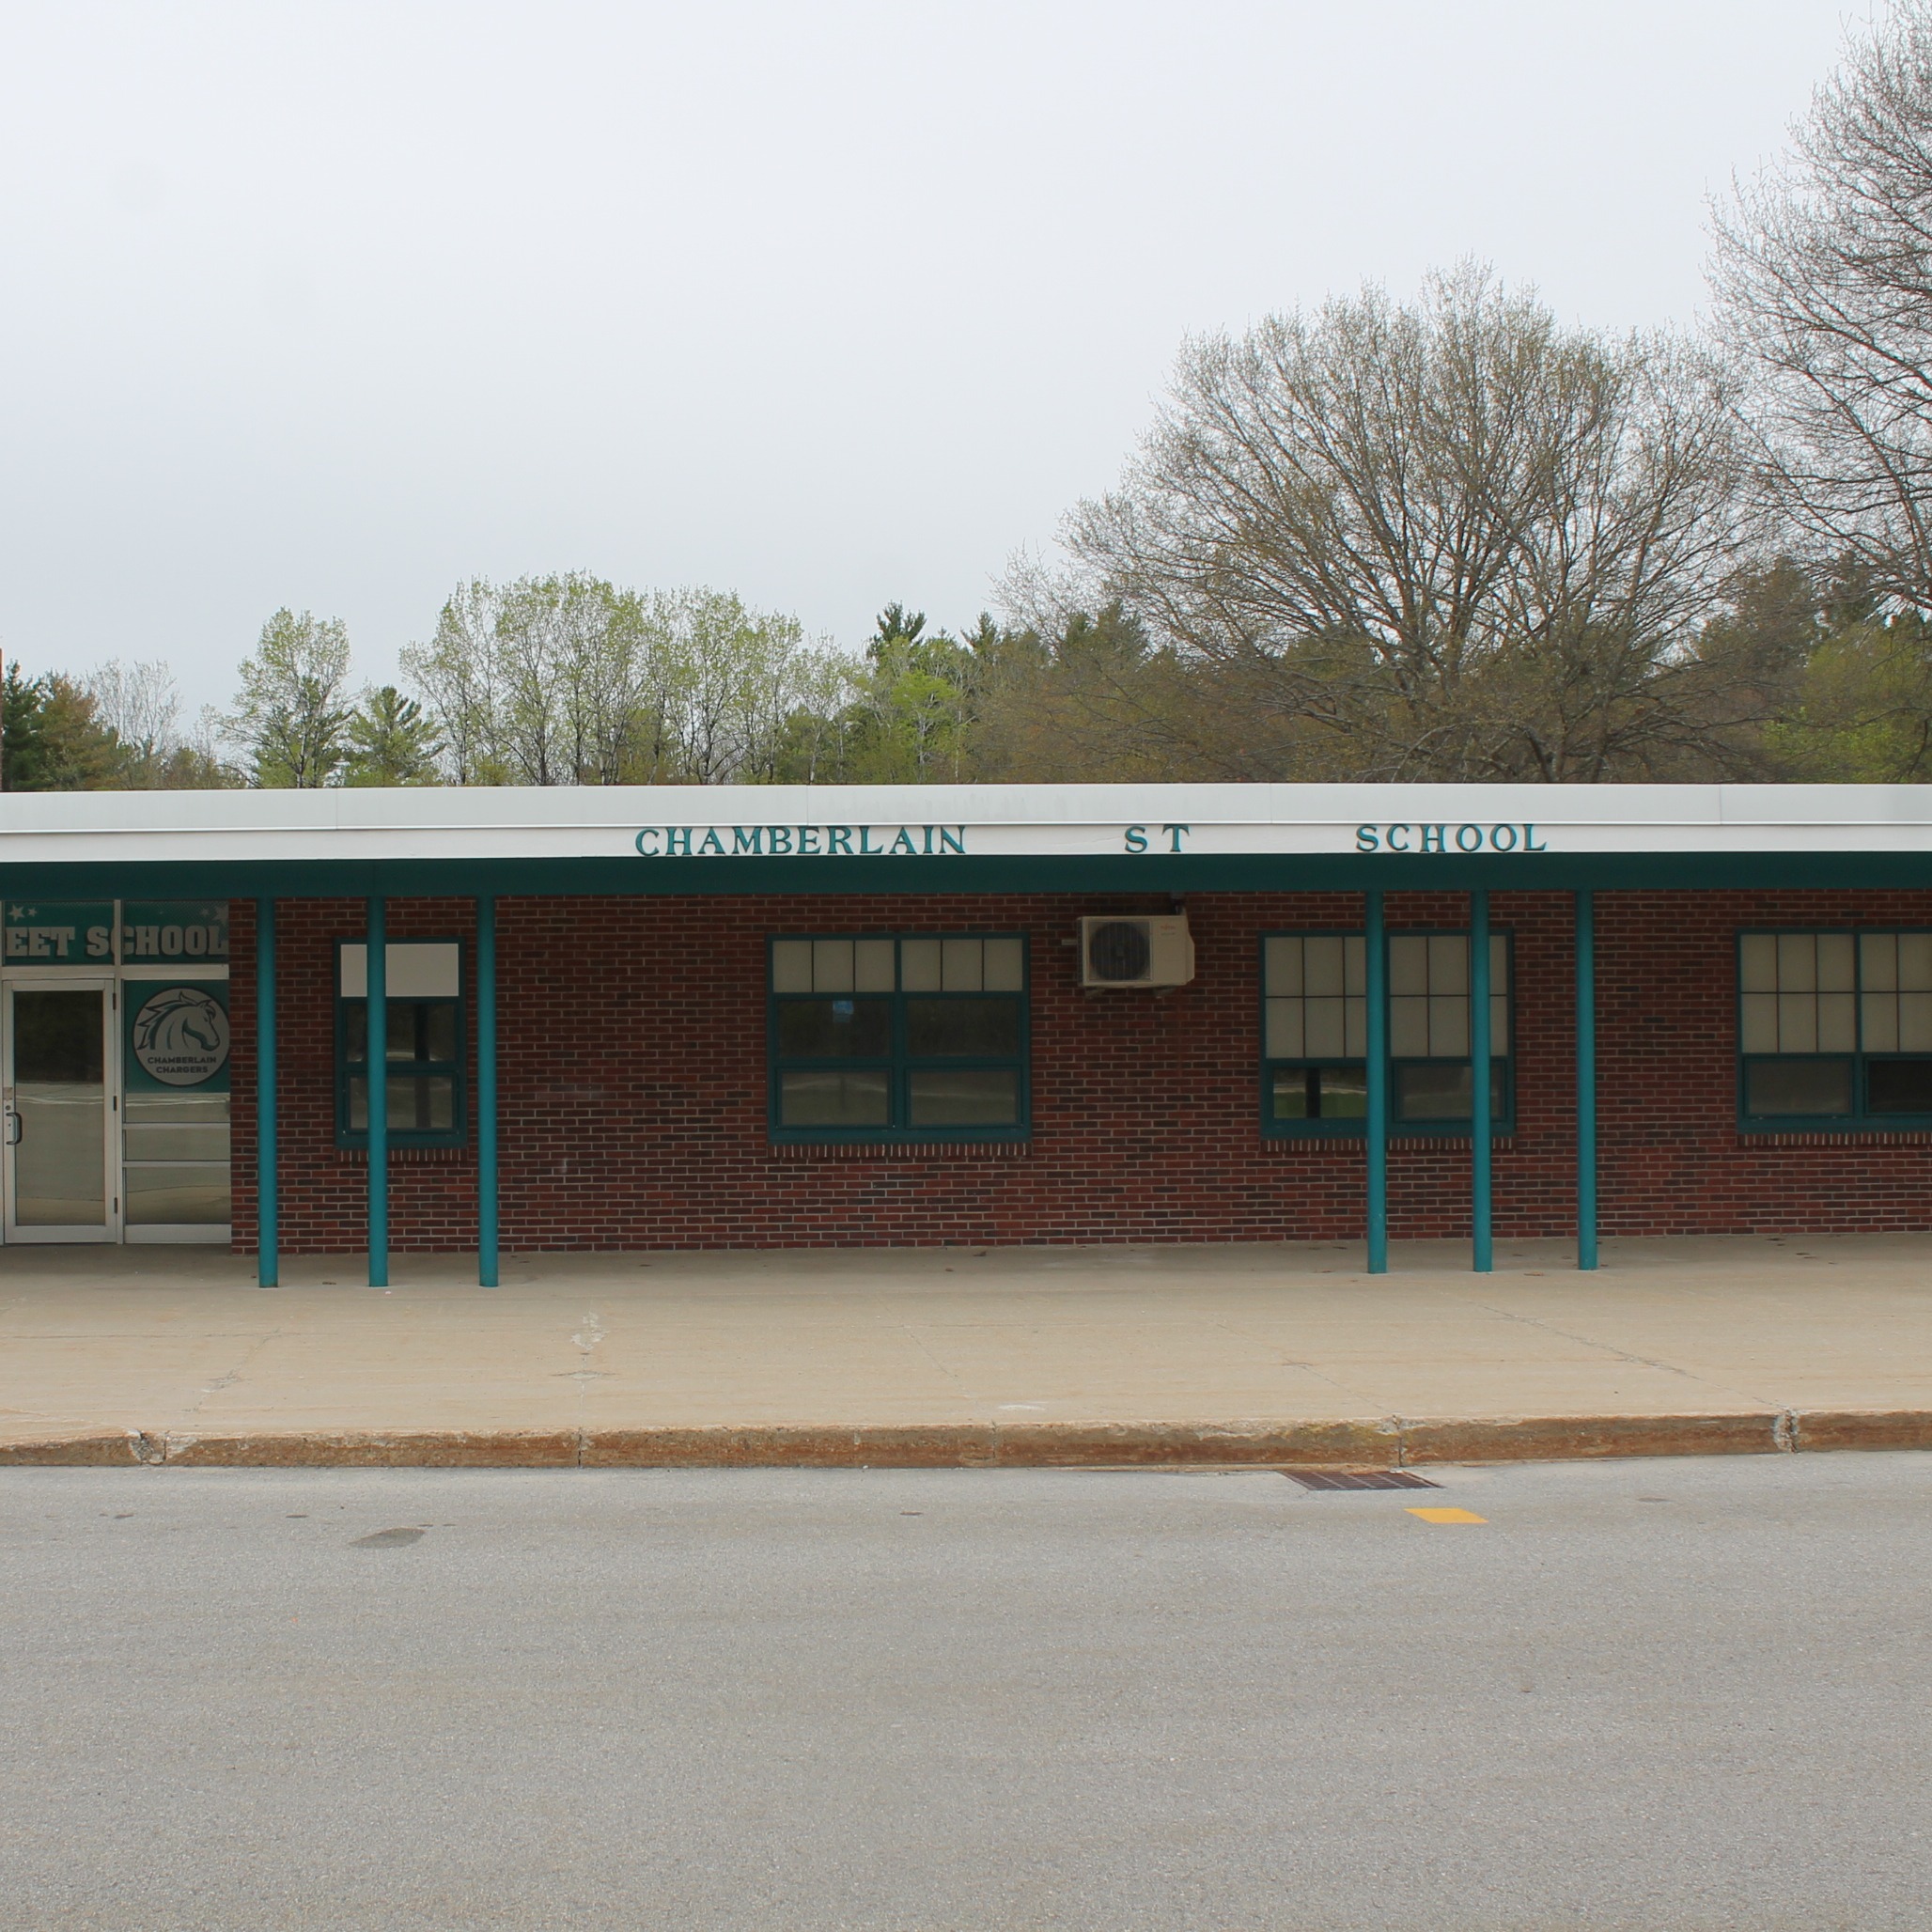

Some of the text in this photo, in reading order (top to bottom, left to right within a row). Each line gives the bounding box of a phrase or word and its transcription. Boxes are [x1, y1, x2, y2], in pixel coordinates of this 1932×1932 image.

[635, 824, 1547, 856] CHAMBERLAIN ST SCHOOL
[86, 926, 229, 956] SCHOOL
[156, 1066, 209, 1074] CHARGERS
